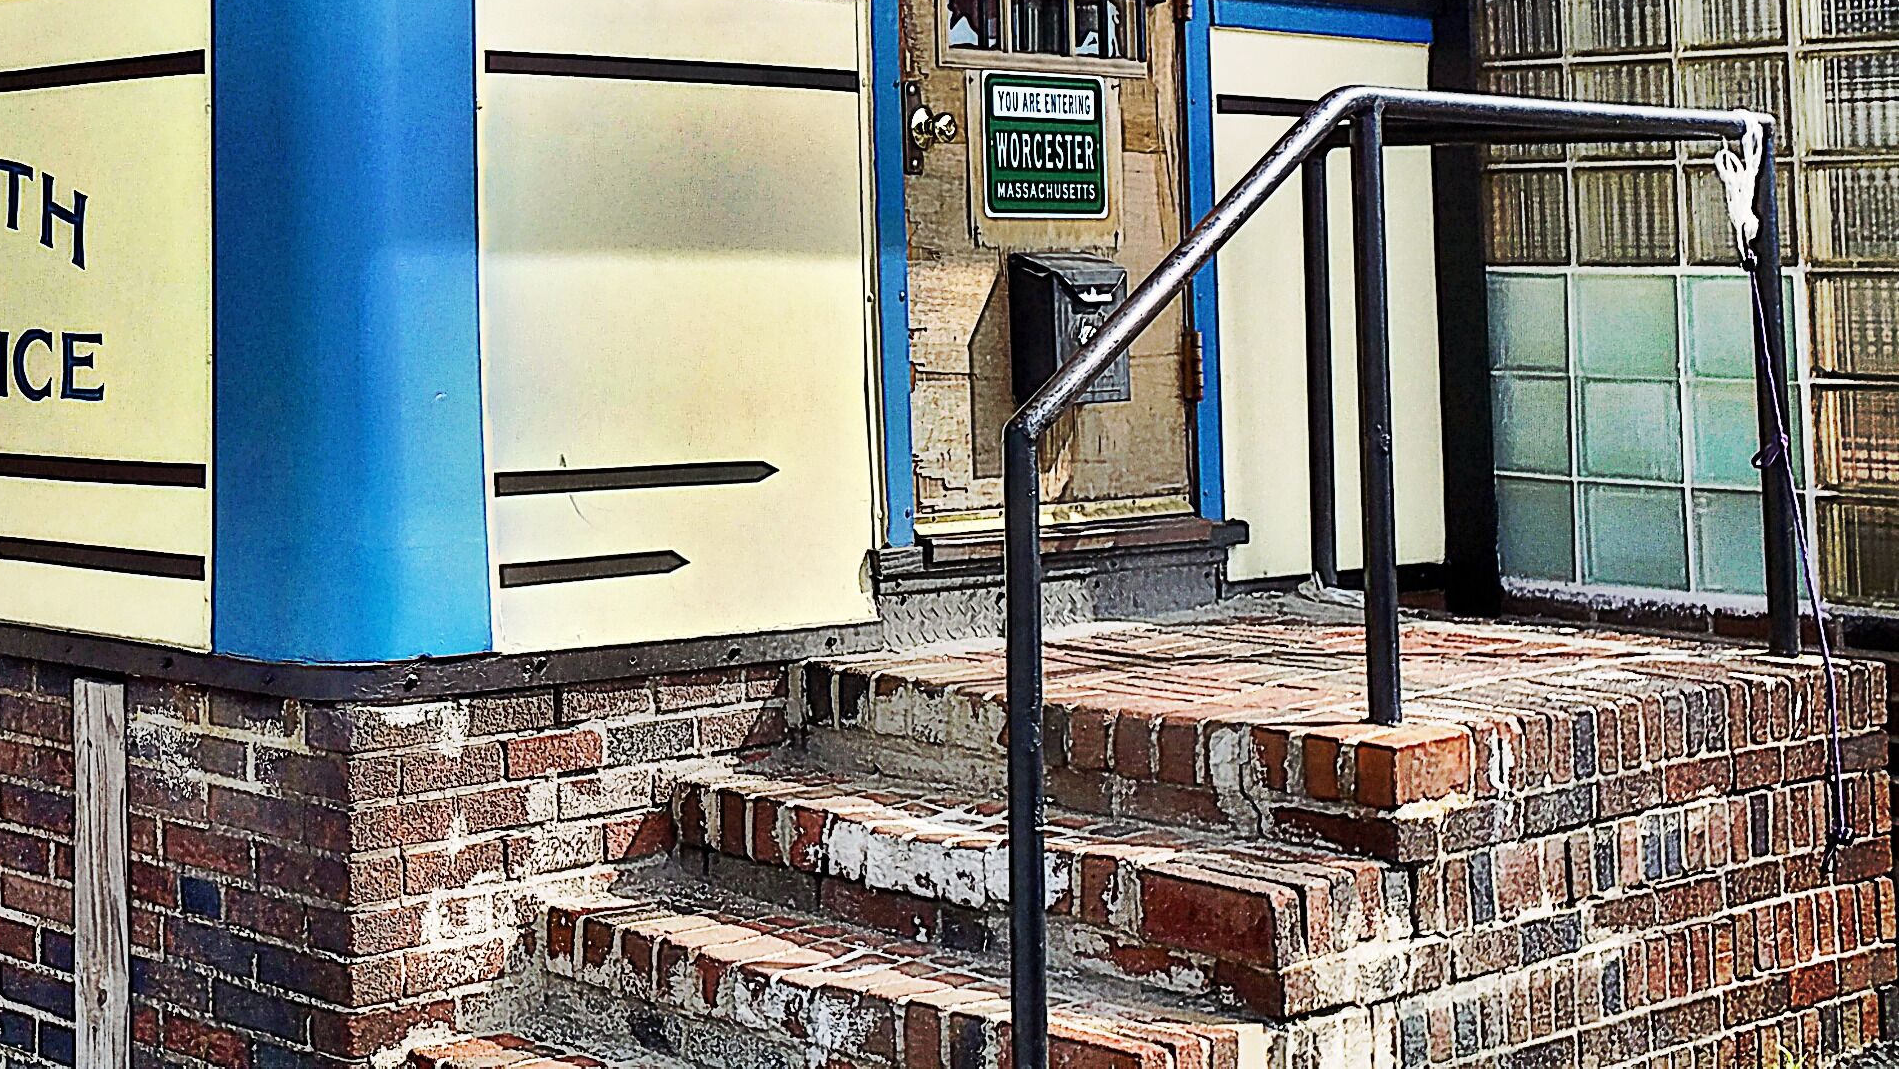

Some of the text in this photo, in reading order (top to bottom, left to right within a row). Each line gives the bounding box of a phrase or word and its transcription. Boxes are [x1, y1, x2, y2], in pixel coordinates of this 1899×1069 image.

[997, 91, 1091, 116] YOU ARE ENTERING
[995, 131, 1095, 170] WORCESTER
[997, 182, 1096, 200] MASSACHUSETTS
